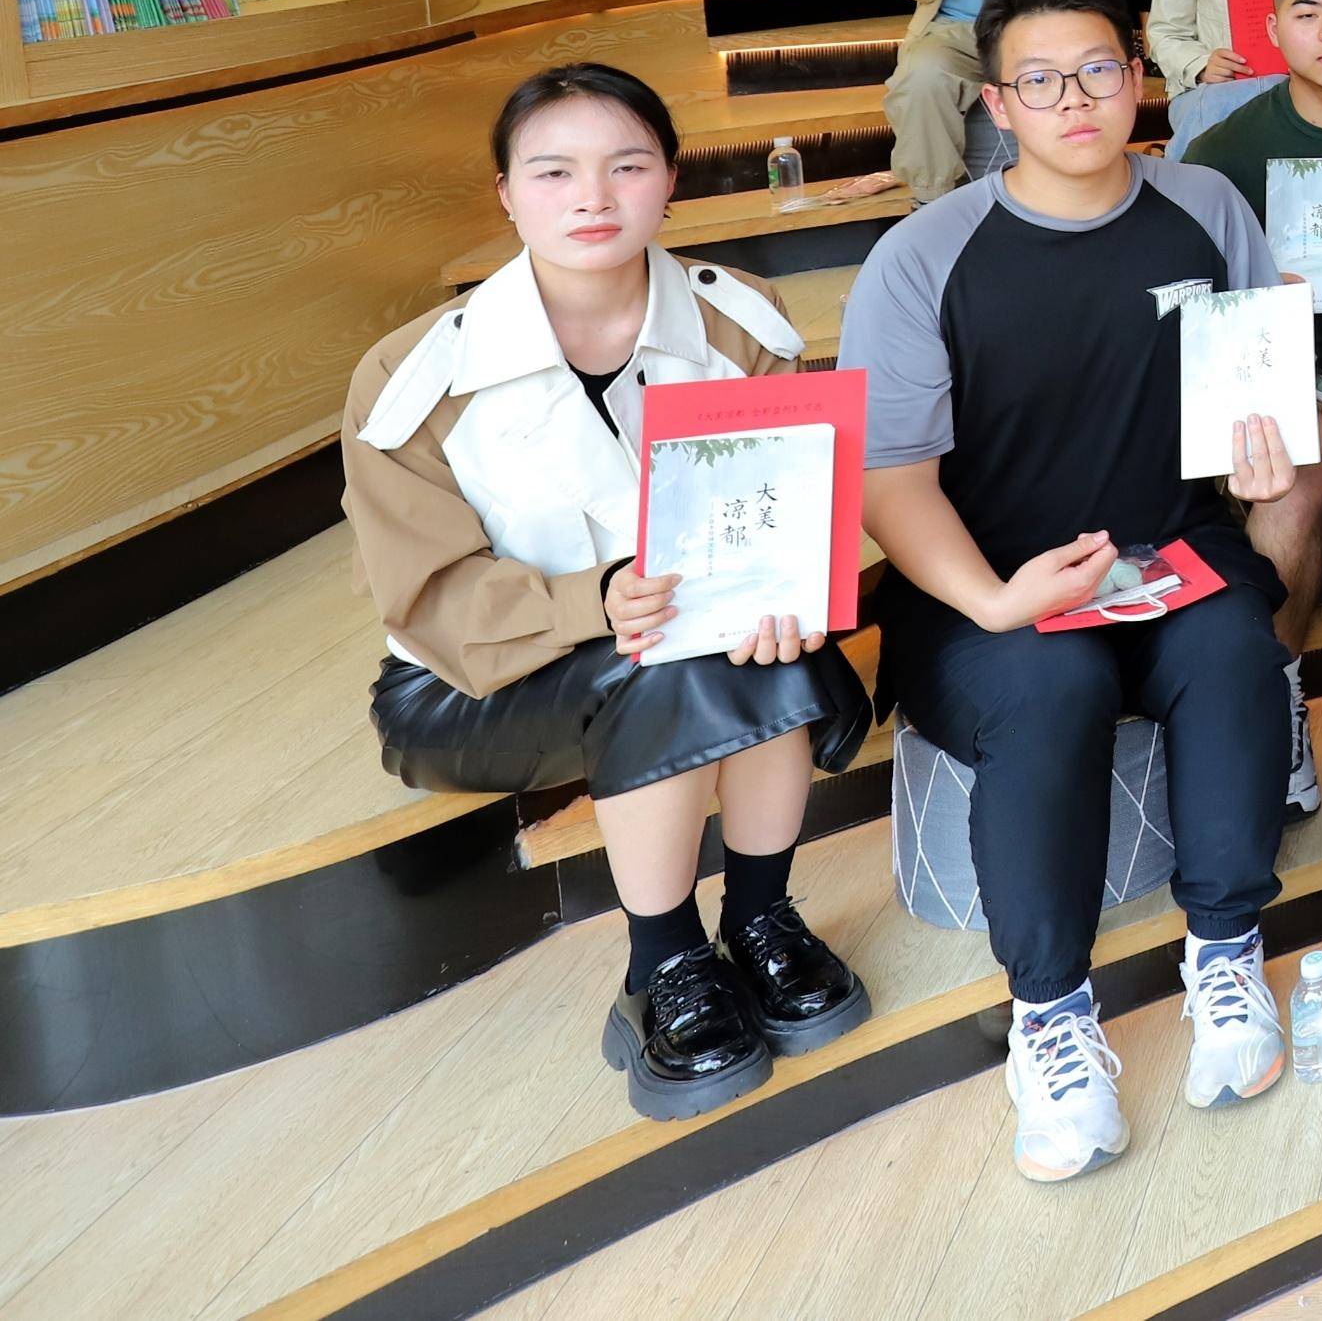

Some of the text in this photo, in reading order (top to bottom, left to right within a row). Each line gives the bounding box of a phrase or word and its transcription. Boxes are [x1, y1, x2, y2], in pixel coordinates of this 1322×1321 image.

[1157, 281, 1213, 316] WARRIORS
[1257, 326, 1272, 369] 大美
[720, 498, 748, 548] 凉都
[756, 482, 778, 530] 大美
